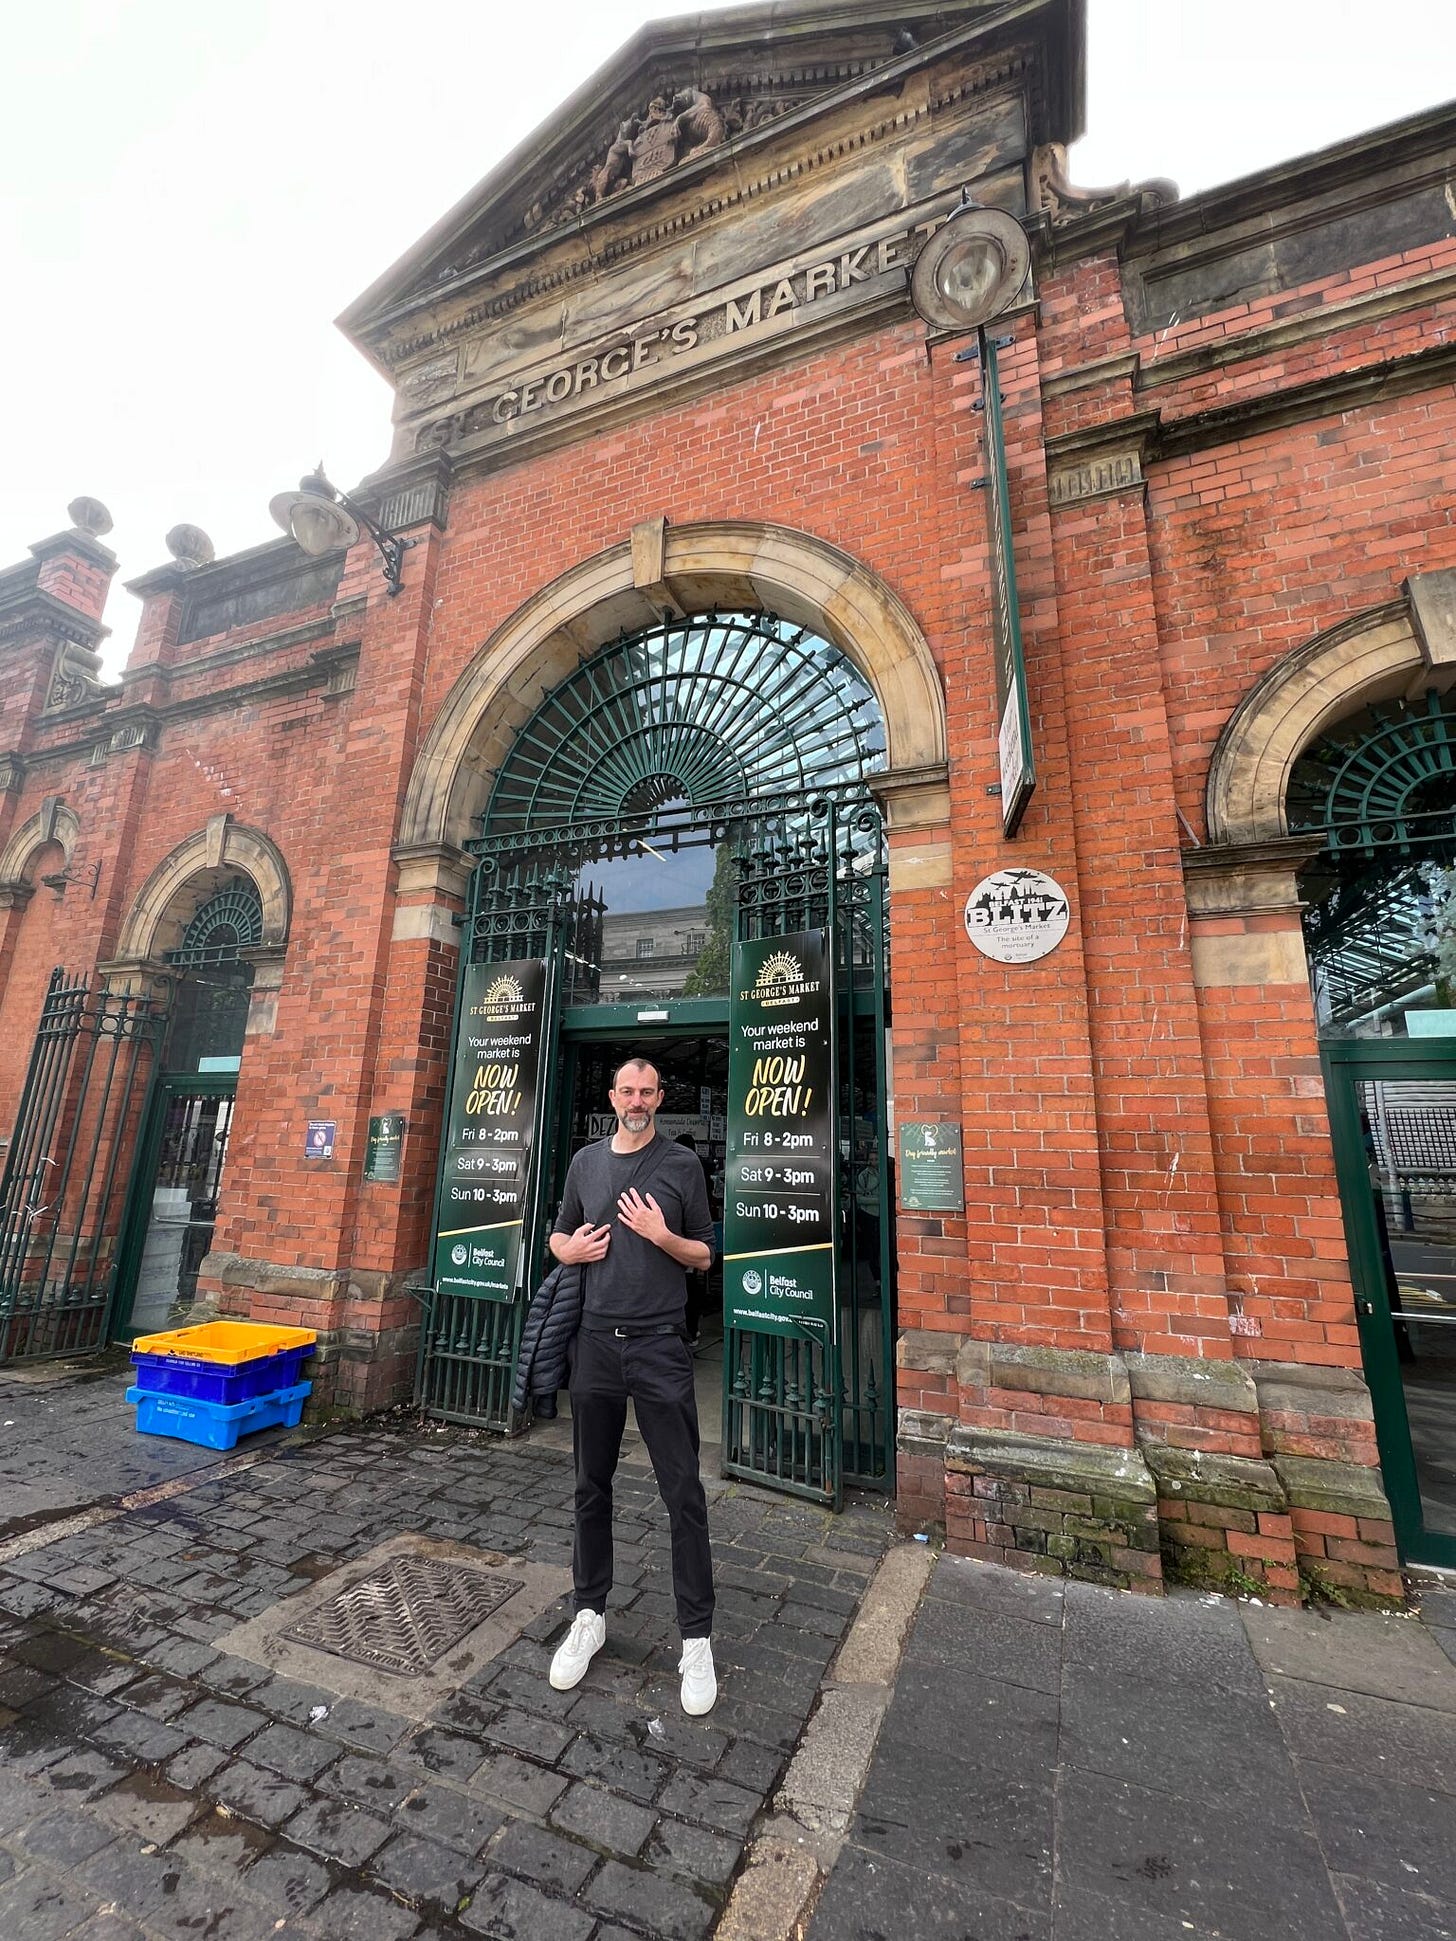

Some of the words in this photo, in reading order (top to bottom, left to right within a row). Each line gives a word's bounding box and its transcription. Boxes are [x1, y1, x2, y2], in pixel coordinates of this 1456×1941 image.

[492, 317, 698, 424] GEORGE'S
[726, 213, 948, 334] MARKET
[967, 900, 1067, 928] BLITZ
[992, 925, 1023, 933] George's
[740, 991, 749, 1001] ST
[750, 985, 787, 999] GEORGE'S
[788, 981, 820, 995] MARKET
[470, 1006, 478, 1016] ST
[478, 1004, 509, 1015] GEORGE'S
[510, 1002, 536, 1012] MARKET
[741, 1025, 766, 1038] Your
[767, 1017, 819, 1035] weekend
[468, 1036, 489, 1047] Your
[490, 1033, 532, 1046] weekend
[753, 1036, 794, 1051] market
[795, 1035, 806, 1048] is
[477, 1047, 511, 1059] market
[511, 1047, 520, 1058] is
[473, 1063, 519, 1090] NOW
[752, 1054, 806, 1087] NOW
[465, 1089, 522, 1116] OPEN!
[744, 1085, 813, 1117] OPEN!
[462, 1128, 476, 1140] Fri
[478, 1127, 487, 1140] 8
[493, 1127, 519, 1143] 2pm
[743, 1132, 759, 1146] Fri
[763, 1131, 773, 1147] 8
[782, 1131, 813, 1150] 2pm
[457, 1157, 476, 1170] Sat
[476, 1157, 485, 1171] 9
[491, 1158, 517, 1174] 3pm
[741, 1166, 763, 1182] Sat
[764, 1167, 774, 1182] 9
[783, 1168, 815, 1186] 3pm
[450, 1187, 471, 1200] Sun
[472, 1188, 485, 1201] 10
[492, 1189, 517, 1205] 3pm
[736, 1201, 761, 1218] Sun
[762, 1203, 778, 1219] 10
[787, 1205, 820, 1224] 3pm
[472, 1247, 495, 1258] Belfast
[472, 1256, 484, 1267] City
[484, 1257, 505, 1267] Council
[769, 1274, 797, 1288] Belfast
[769, 1285, 784, 1298] City
[785, 1287, 813, 1300] Council
